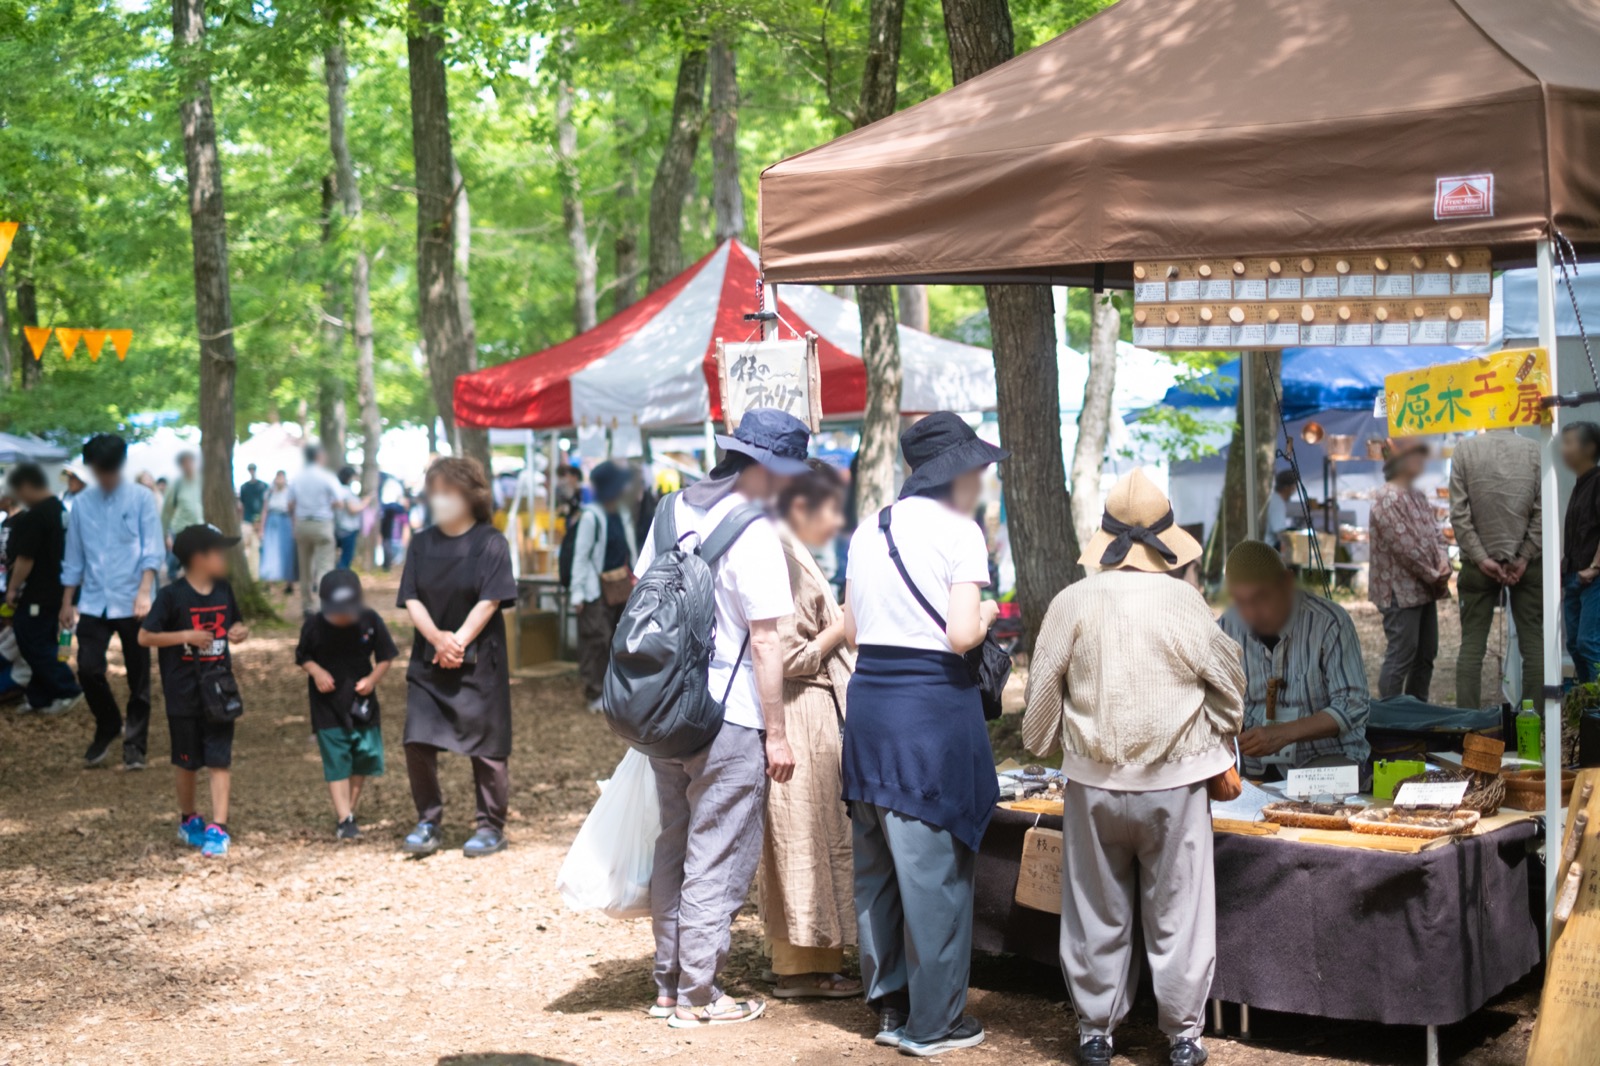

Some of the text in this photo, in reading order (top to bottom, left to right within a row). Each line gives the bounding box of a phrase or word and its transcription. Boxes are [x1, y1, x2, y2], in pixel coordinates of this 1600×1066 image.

[730, 354, 770, 382] 枝の
[744, 383, 803, 413] オカリナ
[1396, 371, 1541, 431] 原木工房
